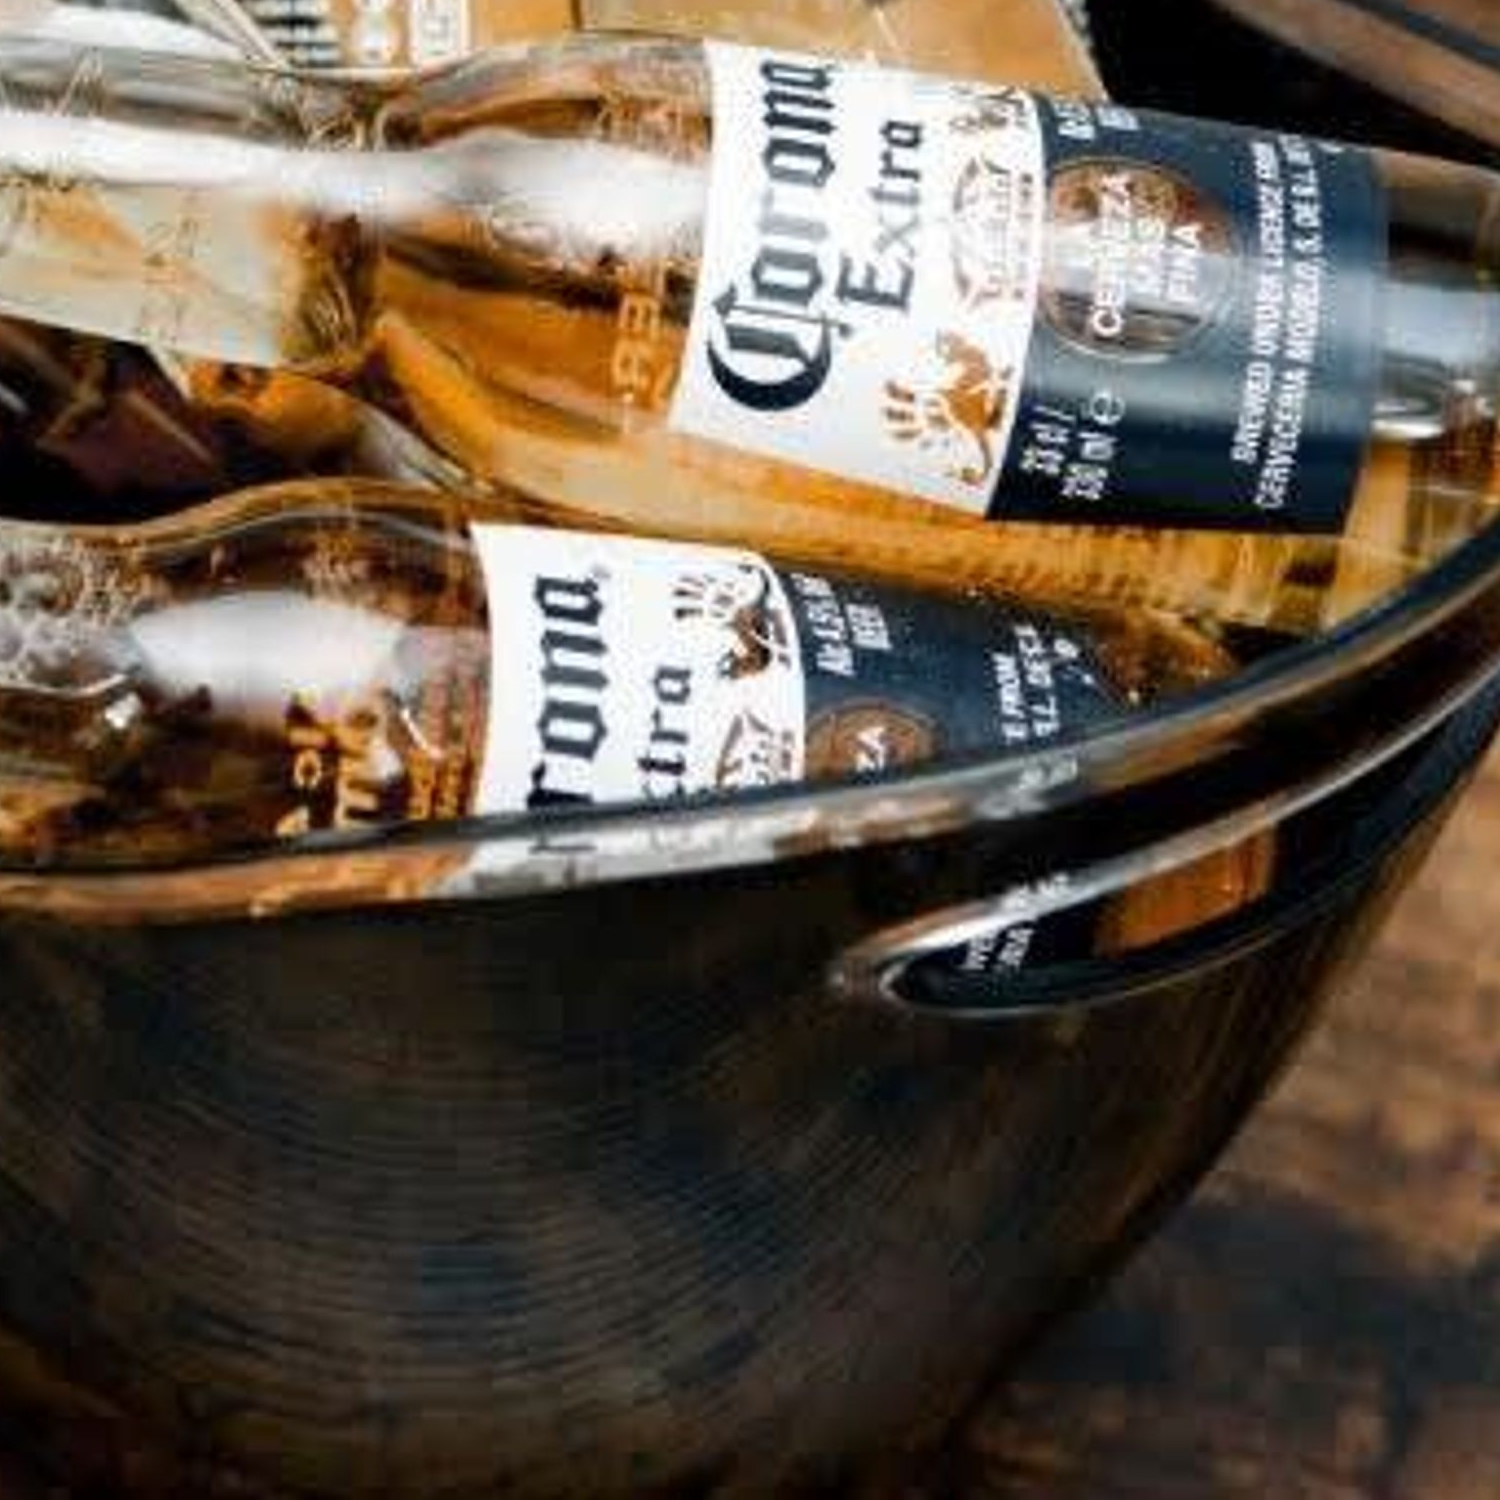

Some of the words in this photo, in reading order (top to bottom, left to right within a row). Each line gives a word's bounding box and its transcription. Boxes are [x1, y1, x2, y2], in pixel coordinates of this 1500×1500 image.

[705, 60, 852, 413] Corona
[835, 119, 925, 312] Extra
[1230, 361, 1274, 466] BREWED
[526, 574, 611, 810] rona
